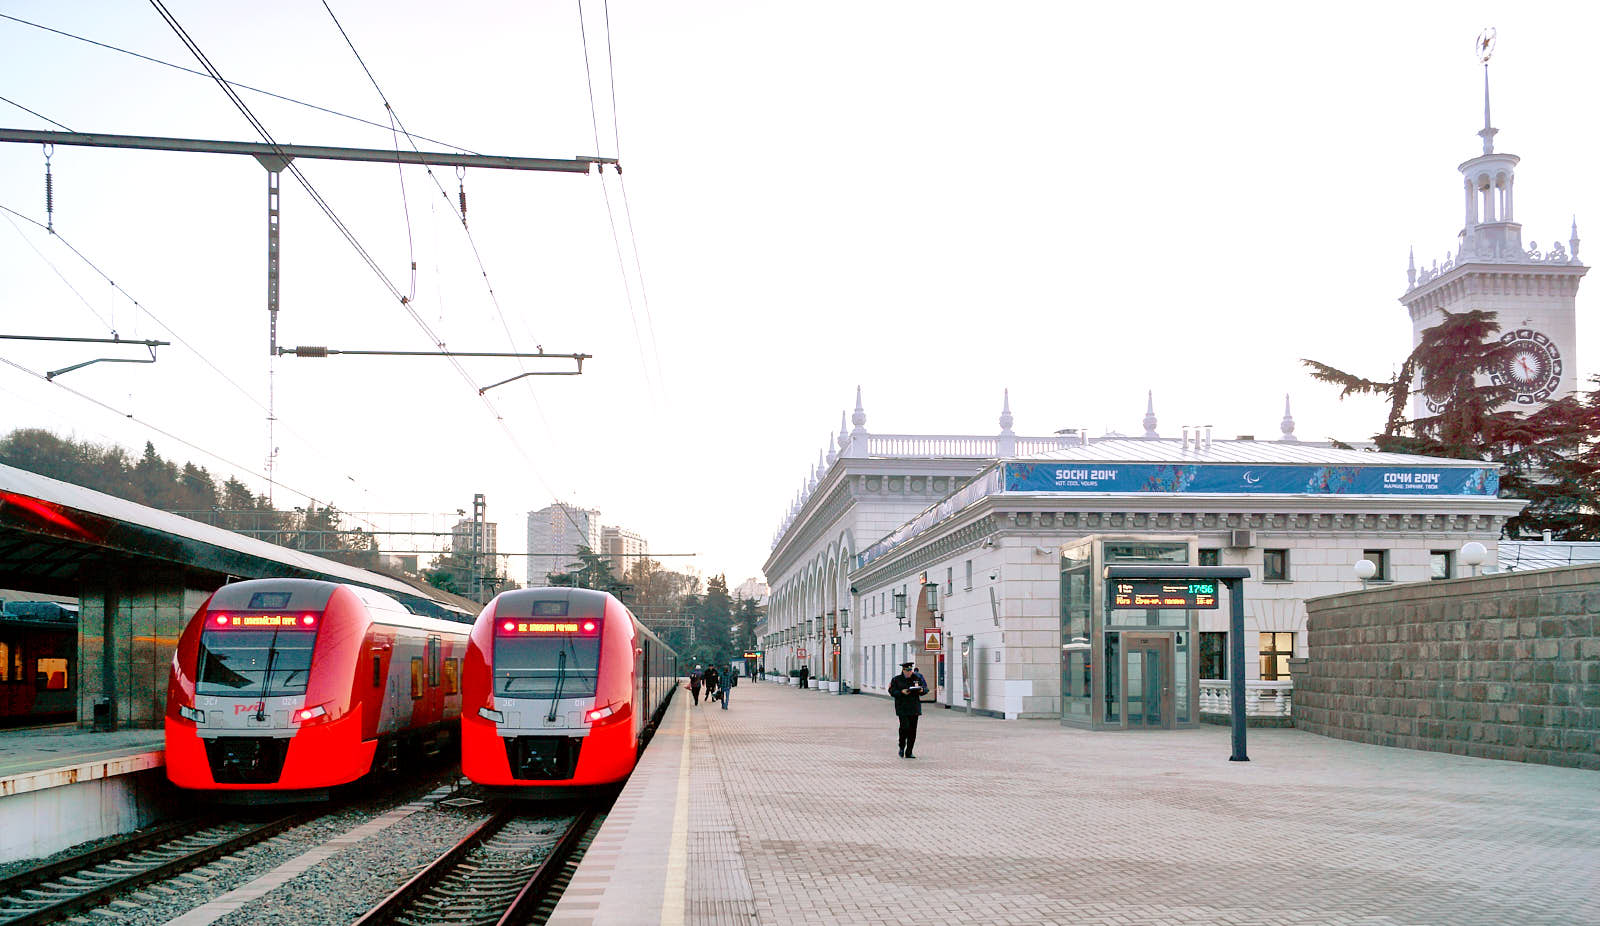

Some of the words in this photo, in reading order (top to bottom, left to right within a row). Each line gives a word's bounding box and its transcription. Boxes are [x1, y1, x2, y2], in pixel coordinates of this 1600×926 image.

[1055, 469, 1088, 480] SOCHI
[1090, 469, 1116, 480] 2014
[1384, 473, 1412, 483] СОЧИ
[1414, 473, 1438, 483] 2014
[1188, 584, 1214, 594] 17:56
